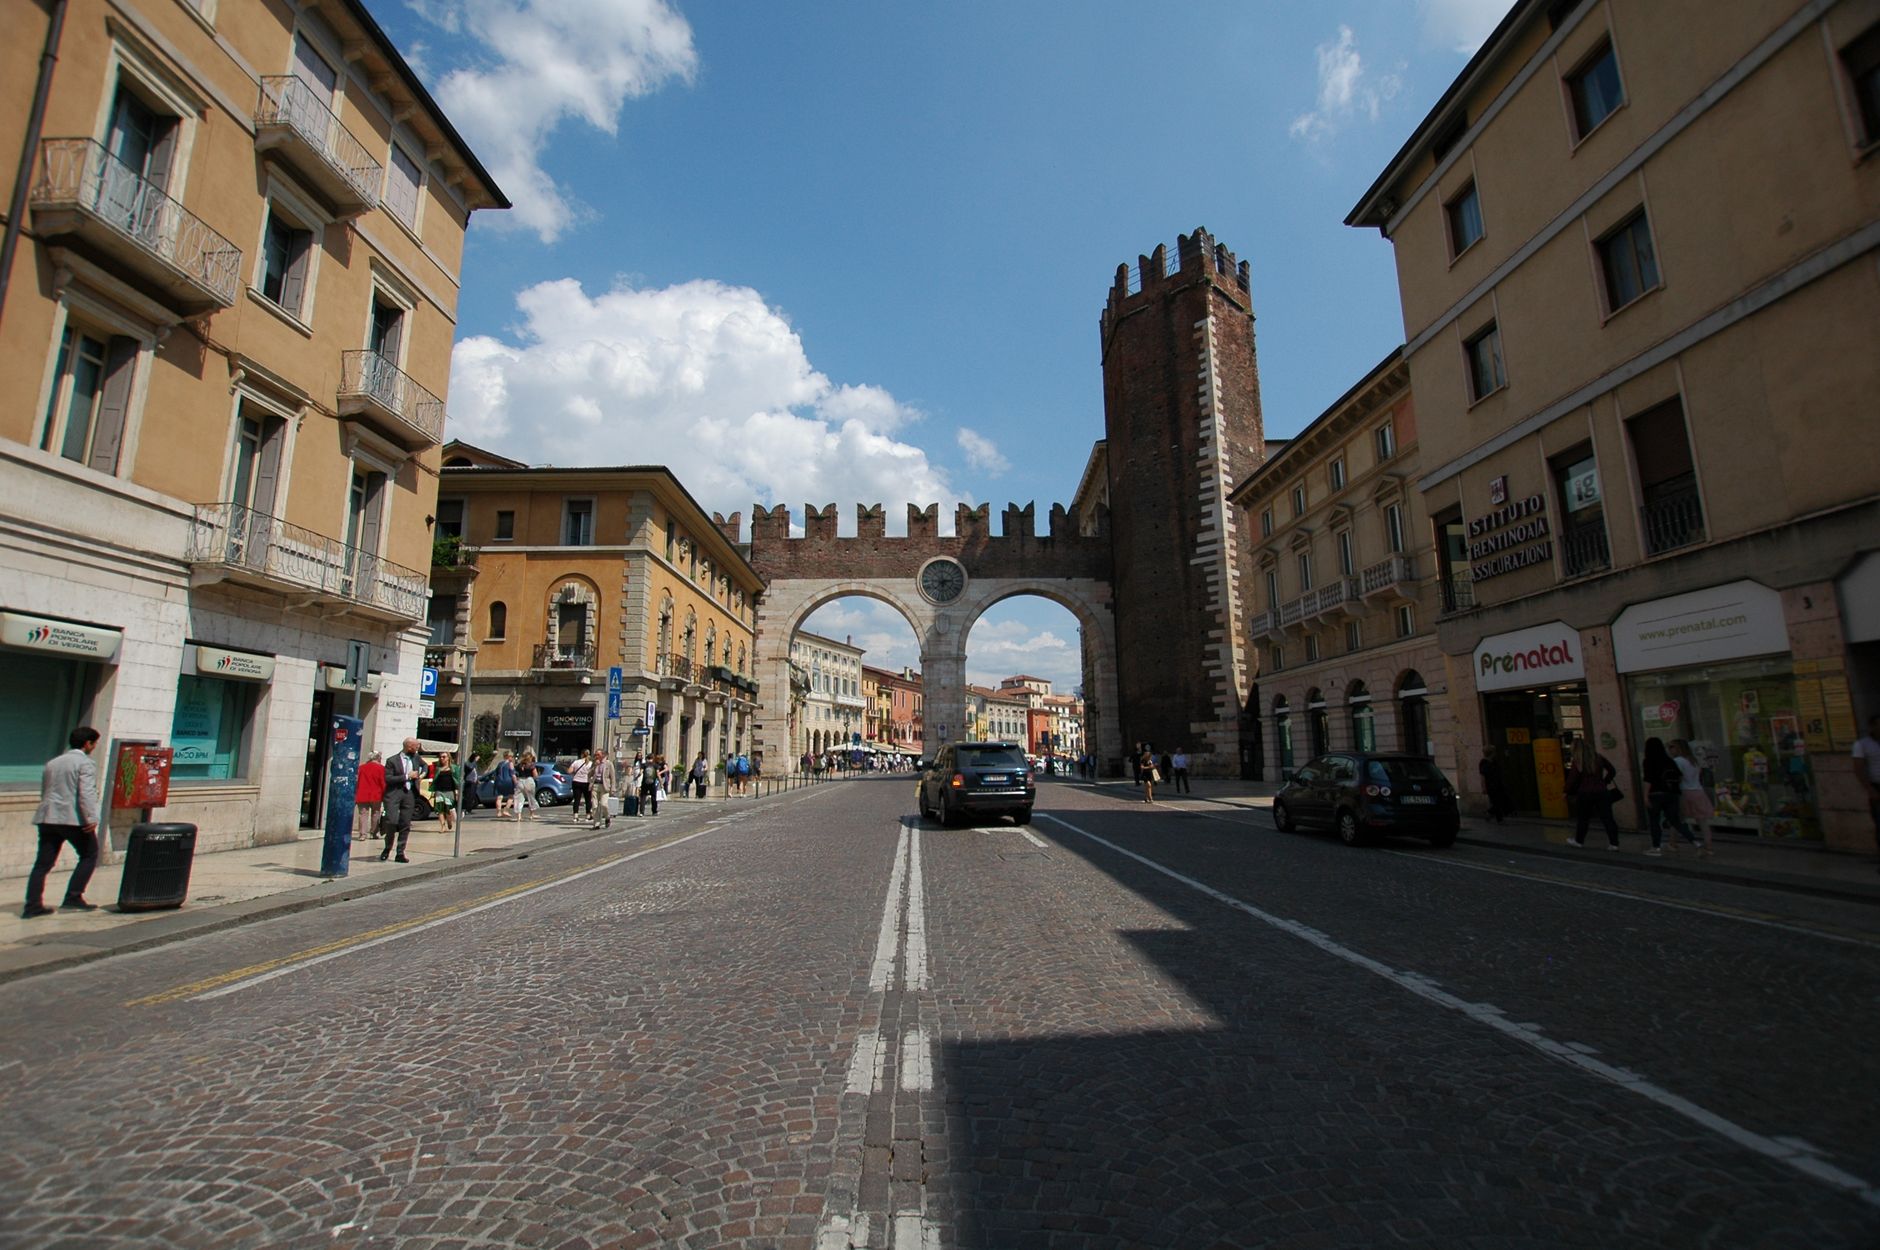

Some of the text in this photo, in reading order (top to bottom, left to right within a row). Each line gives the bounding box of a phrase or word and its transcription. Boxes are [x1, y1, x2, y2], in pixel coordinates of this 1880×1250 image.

[1468, 495, 1541, 538] ISTITUTO
[1472, 542, 1550, 582] ASSICURAZIONI
[52, 627, 85, 638] BANCA
[1638, 613, 1747, 642] www.prenatal.com
[50, 633, 98, 646] POPOLARE
[61, 642, 98, 652] VERONA
[422, 670, 434, 692] P
